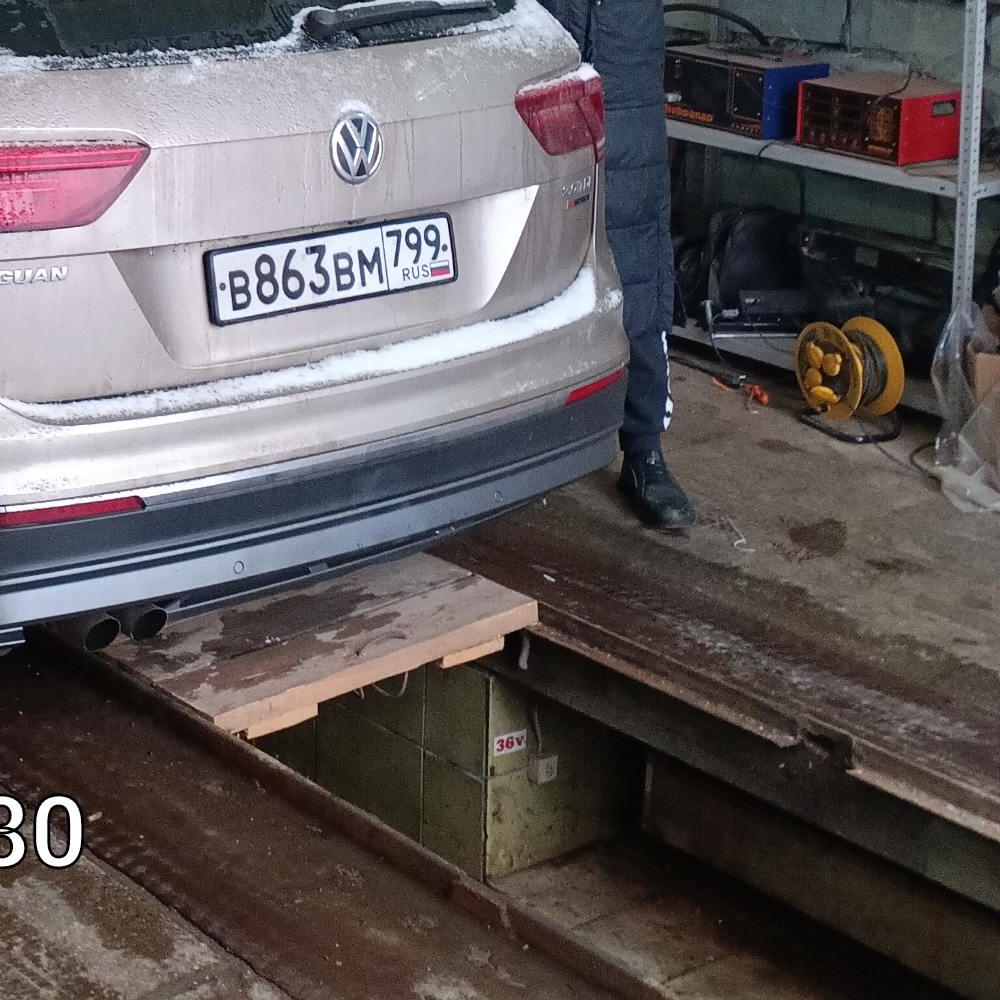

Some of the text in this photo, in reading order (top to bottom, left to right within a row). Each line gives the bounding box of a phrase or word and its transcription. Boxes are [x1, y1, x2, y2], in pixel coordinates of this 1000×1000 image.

[228, 223, 441, 311] В863ВМ 799
[402, 263, 430, 282] RUS
